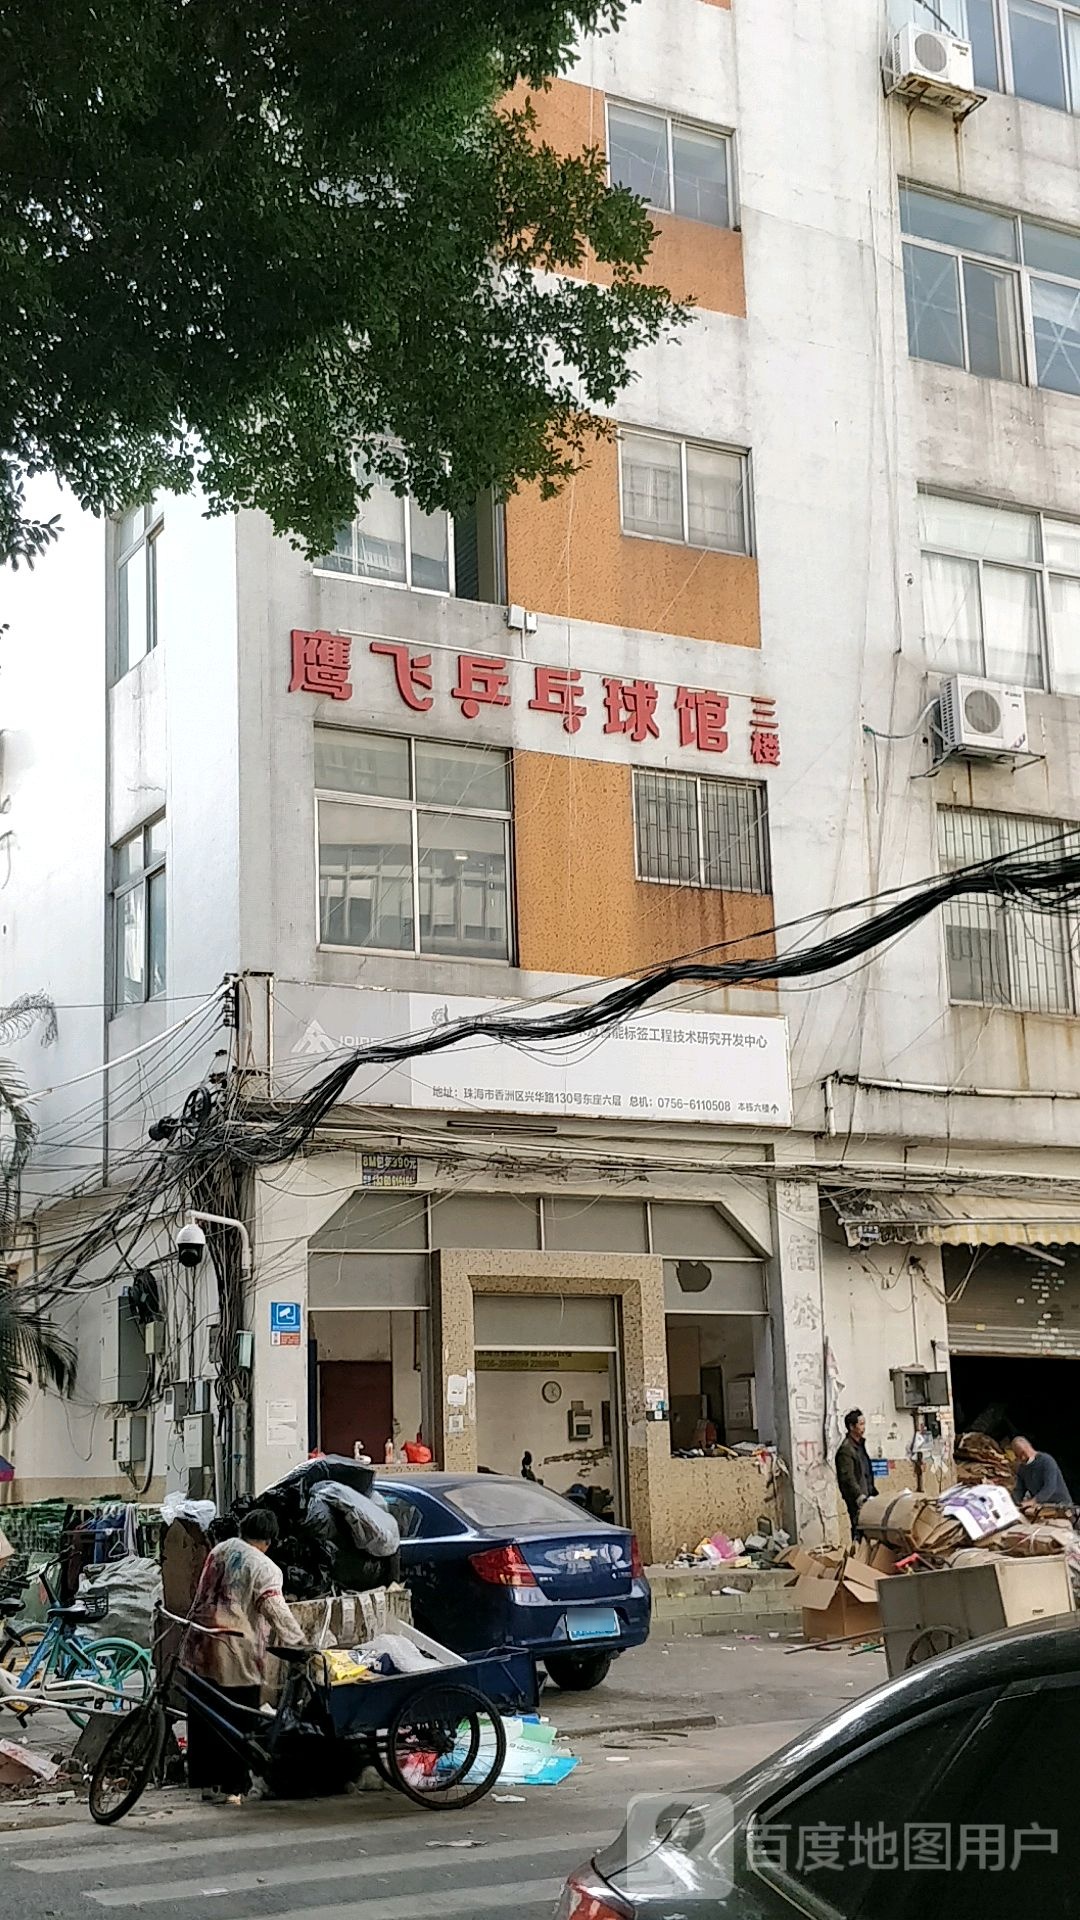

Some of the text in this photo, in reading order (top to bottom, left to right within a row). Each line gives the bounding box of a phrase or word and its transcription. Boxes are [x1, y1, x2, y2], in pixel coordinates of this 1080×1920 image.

[288, 629, 729, 752] 鹰飞乒乓球馆
[750, 696, 780, 766] 三楼
